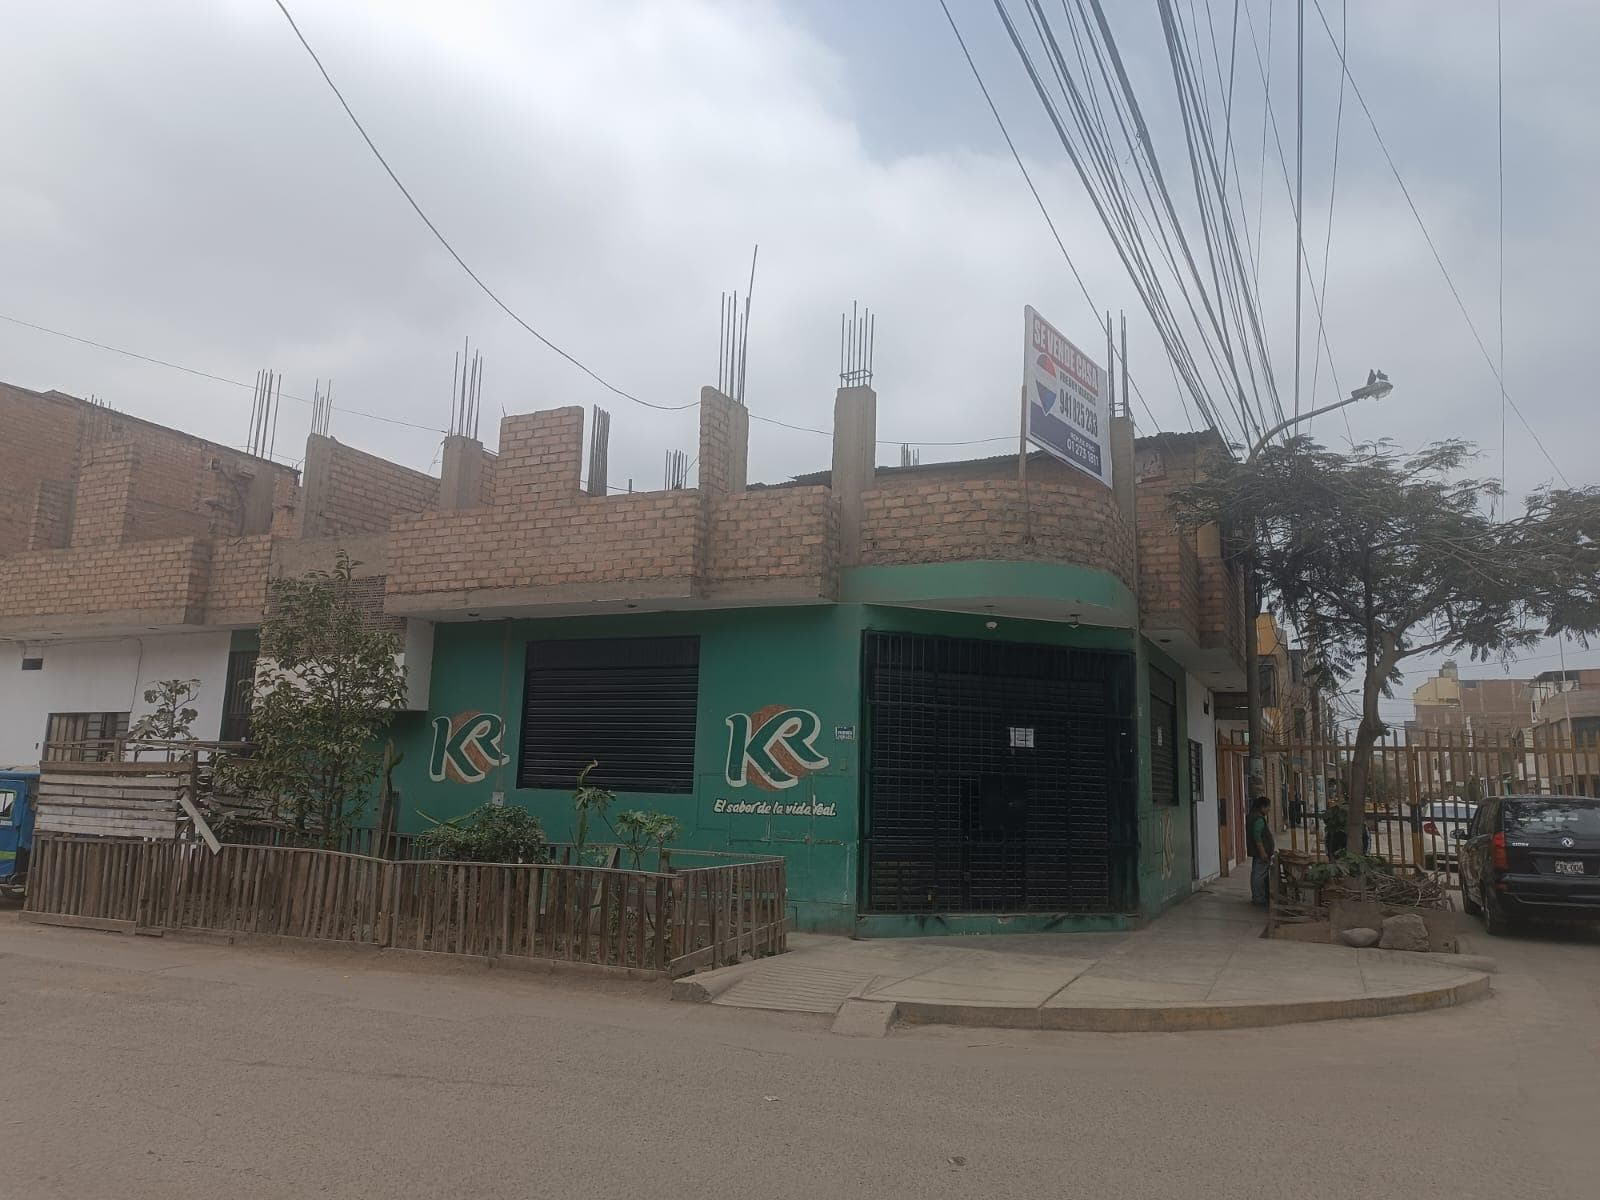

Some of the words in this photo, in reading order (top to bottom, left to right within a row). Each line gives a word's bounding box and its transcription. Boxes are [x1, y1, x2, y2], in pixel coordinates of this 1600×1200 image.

[1034, 319, 1046, 349] SE
[1047, 328, 1075, 372] VENDE
[1076, 353, 1098, 391] CASA
[1060, 388, 1072, 420] 941
[1086, 407, 1098, 438] 233
[429, 713, 509, 782] KR
[725, 709, 829, 788] KR
[714, 799, 727, 813] El
[727, 801, 757, 814] sabor
[757, 801, 772, 814] de
[773, 801, 784, 814] la
[785, 802, 811, 815] vida
